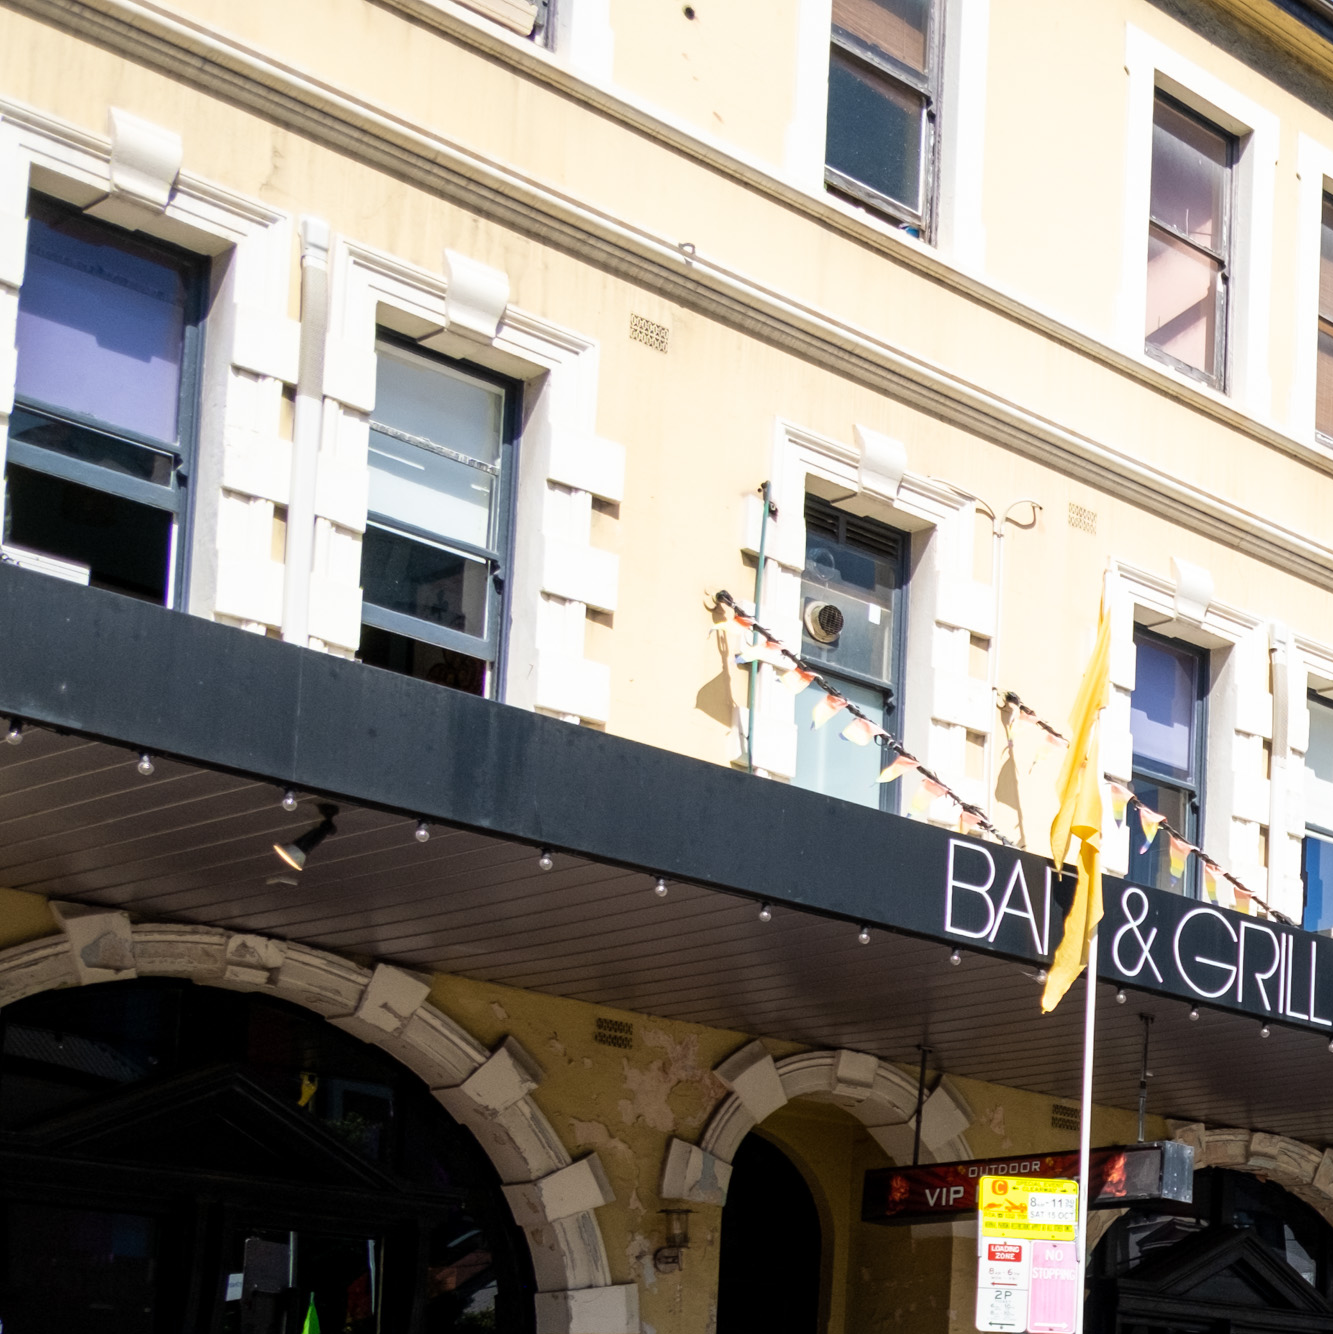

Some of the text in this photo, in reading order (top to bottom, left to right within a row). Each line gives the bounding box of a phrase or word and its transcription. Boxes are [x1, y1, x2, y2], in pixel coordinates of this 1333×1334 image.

[1112, 887, 1163, 983] &
[1174, 907, 1332, 1027] GRILL
[968, 1161, 1041, 1178] OUTDOOR
[925, 1186, 964, 1207] VIP
[1030, 1210, 1045, 1219] SAT
[1048, 1211, 1056, 1219] 15
[1058, 1211, 1074, 1220] OCT
[991, 1245, 1020, 1253] LOADING
[1045, 1249, 1063, 1261] NO
[994, 1252, 1016, 1260] ZONE
[1032, 1267, 1076, 1280] STOPPING
